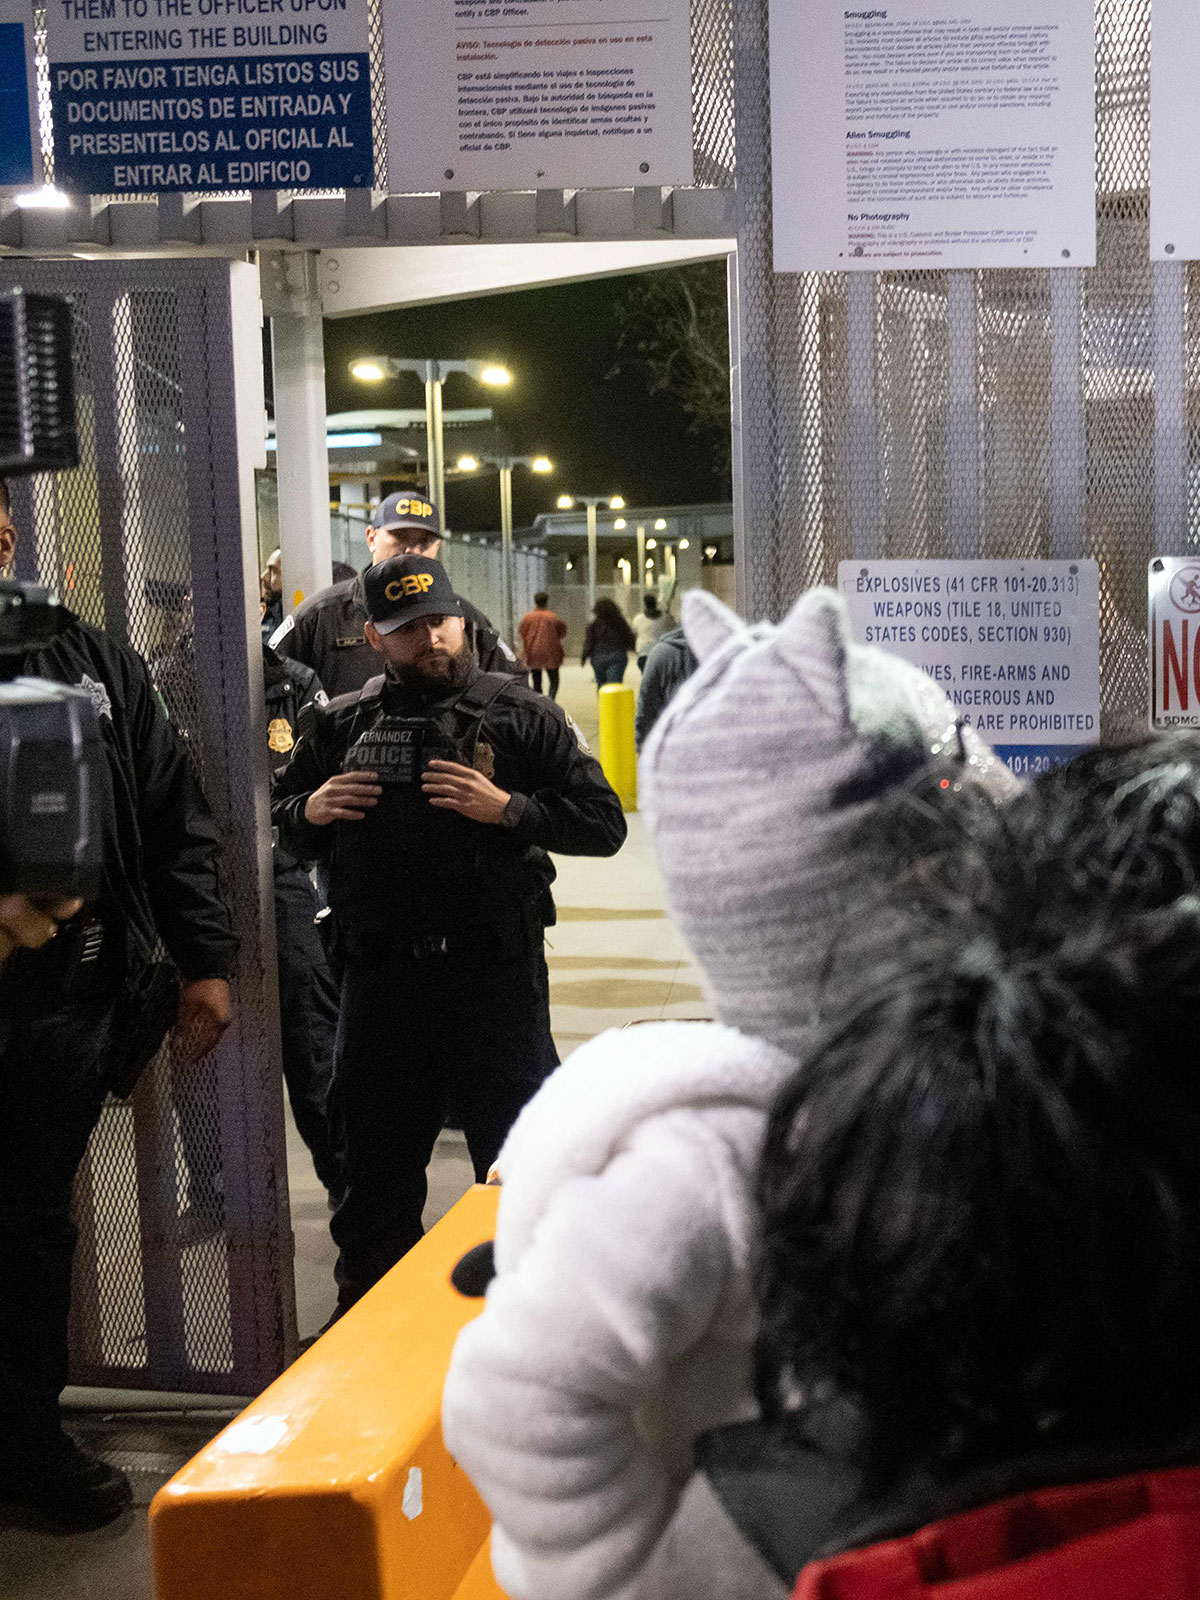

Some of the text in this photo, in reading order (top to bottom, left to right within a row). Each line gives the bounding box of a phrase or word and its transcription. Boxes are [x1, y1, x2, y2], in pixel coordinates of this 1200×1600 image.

[62, 0, 346, 19] THEM TO THE OFFICER UPON
[844, 10, 888, 20] Smuggling
[84, 24, 327, 51] ENTERING THE BUILDING
[57, 60, 360, 91] POR FAVOR TENGA LISTOS SUS
[67, 93, 352, 123] DOCUMENTOS DE ENTRADA Y
[69, 125, 354, 156] PRESENTELOS AL OFICIAL AL
[868, 129, 911, 140] Smuggling
[114, 160, 311, 187] ENTRAR AL EDIFICIO
[848, 212, 910, 222] No Photography
[395, 499, 433, 518] CBP
[385, 573, 434, 601] CBP
[856, 576, 1079, 596] EXPLOSIVES (41 CFR 101-20.313)
[873, 601, 1062, 621] WEAPONS (TILE 18, UNITED
[865, 626, 1071, 645] STATES CODES, SECTION 930)
[961, 665, 1070, 681] FIRE-ARMS AND
[946, 690, 1055, 706] ANGEROUS AND
[977, 714, 1004, 730] ARE
[1010, 714, 1094, 730] PROHIBITED
[1164, 716, 1198, 725] SDMC
[362, 730, 413, 743] ERNANDEZ
[344, 746, 413, 766] POLICE
